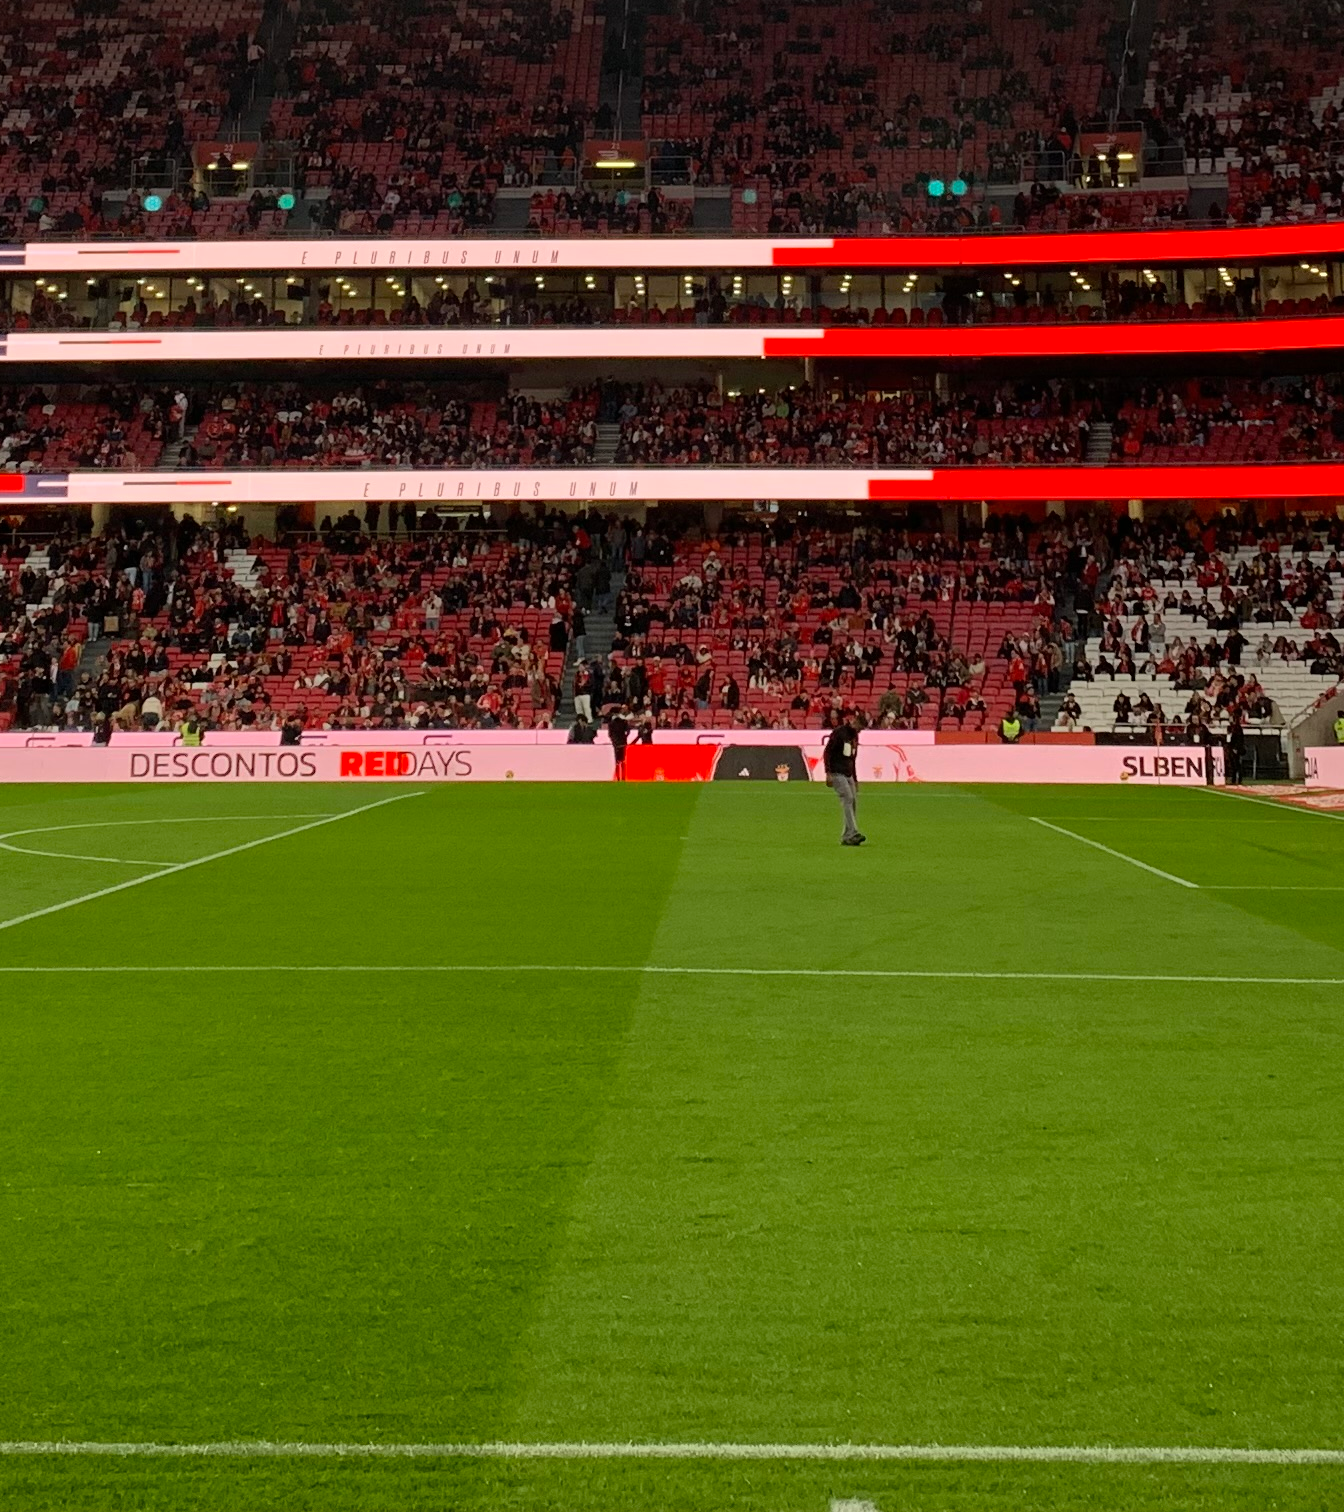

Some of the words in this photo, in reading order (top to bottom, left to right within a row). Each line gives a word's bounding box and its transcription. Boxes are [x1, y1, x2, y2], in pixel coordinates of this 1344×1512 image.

[301, 250, 309, 265] E
[334, 250, 470, 265] PLURIBUS
[494, 249, 562, 264] UNUM
[318, 343, 325, 356] E
[343, 343, 444, 356] PLURIBUS
[461, 343, 512, 355] UNUM
[363, 481, 372, 498] E
[398, 481, 543, 497] PLURIBUS
[569, 480, 641, 497] UNUM
[129, 751, 317, 779] DESCONTOS
